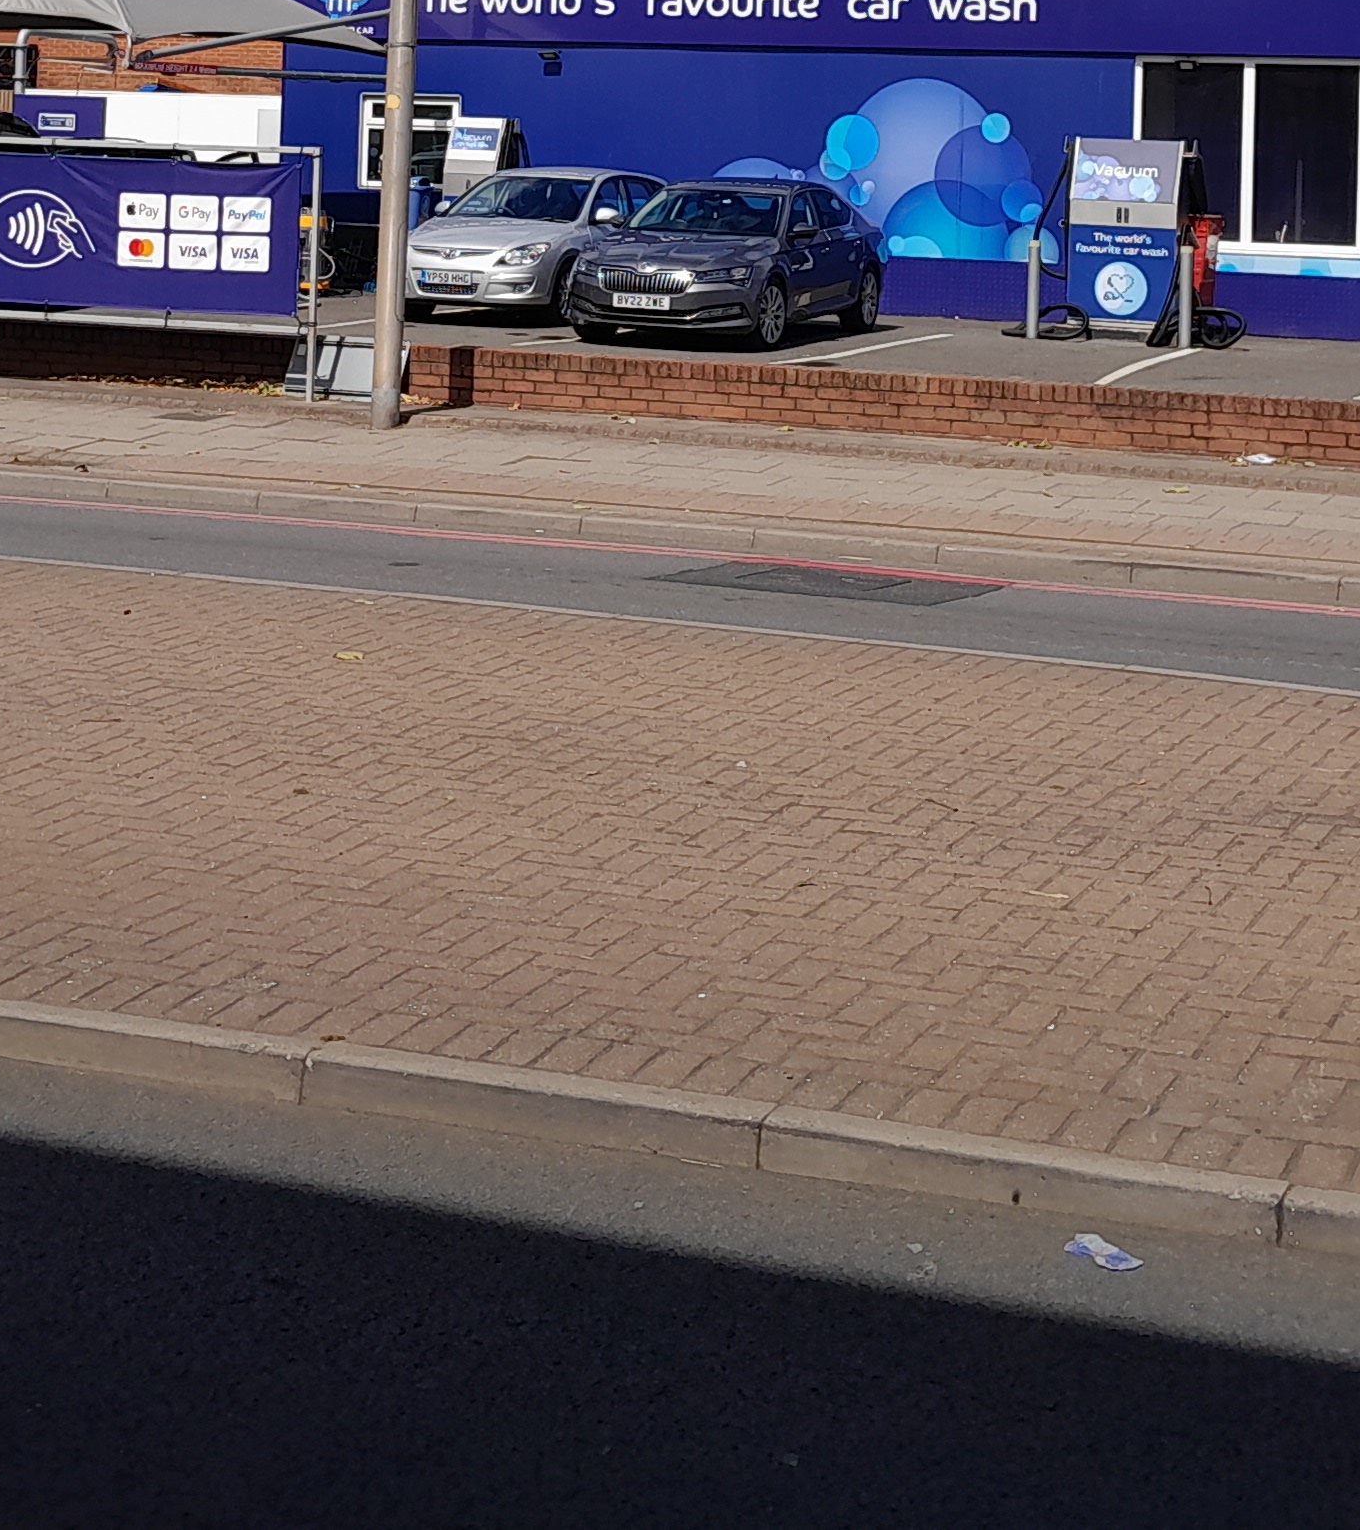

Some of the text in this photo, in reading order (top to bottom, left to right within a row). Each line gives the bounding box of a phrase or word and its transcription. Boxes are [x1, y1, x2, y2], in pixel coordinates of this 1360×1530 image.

[356, 26, 374, 35] CAR
[1093, 162, 1158, 179] Vacuum
[139, 203, 160, 220] Pay
[192, 207, 211, 222] Pay
[228, 209, 266, 223] PayPal
[1093, 232, 1152, 244] The world's
[179, 245, 207, 258] VISA
[231, 247, 259, 259] VISA
[1076, 242, 1121, 255] favourite
[1141, 248, 1169, 257] wash
